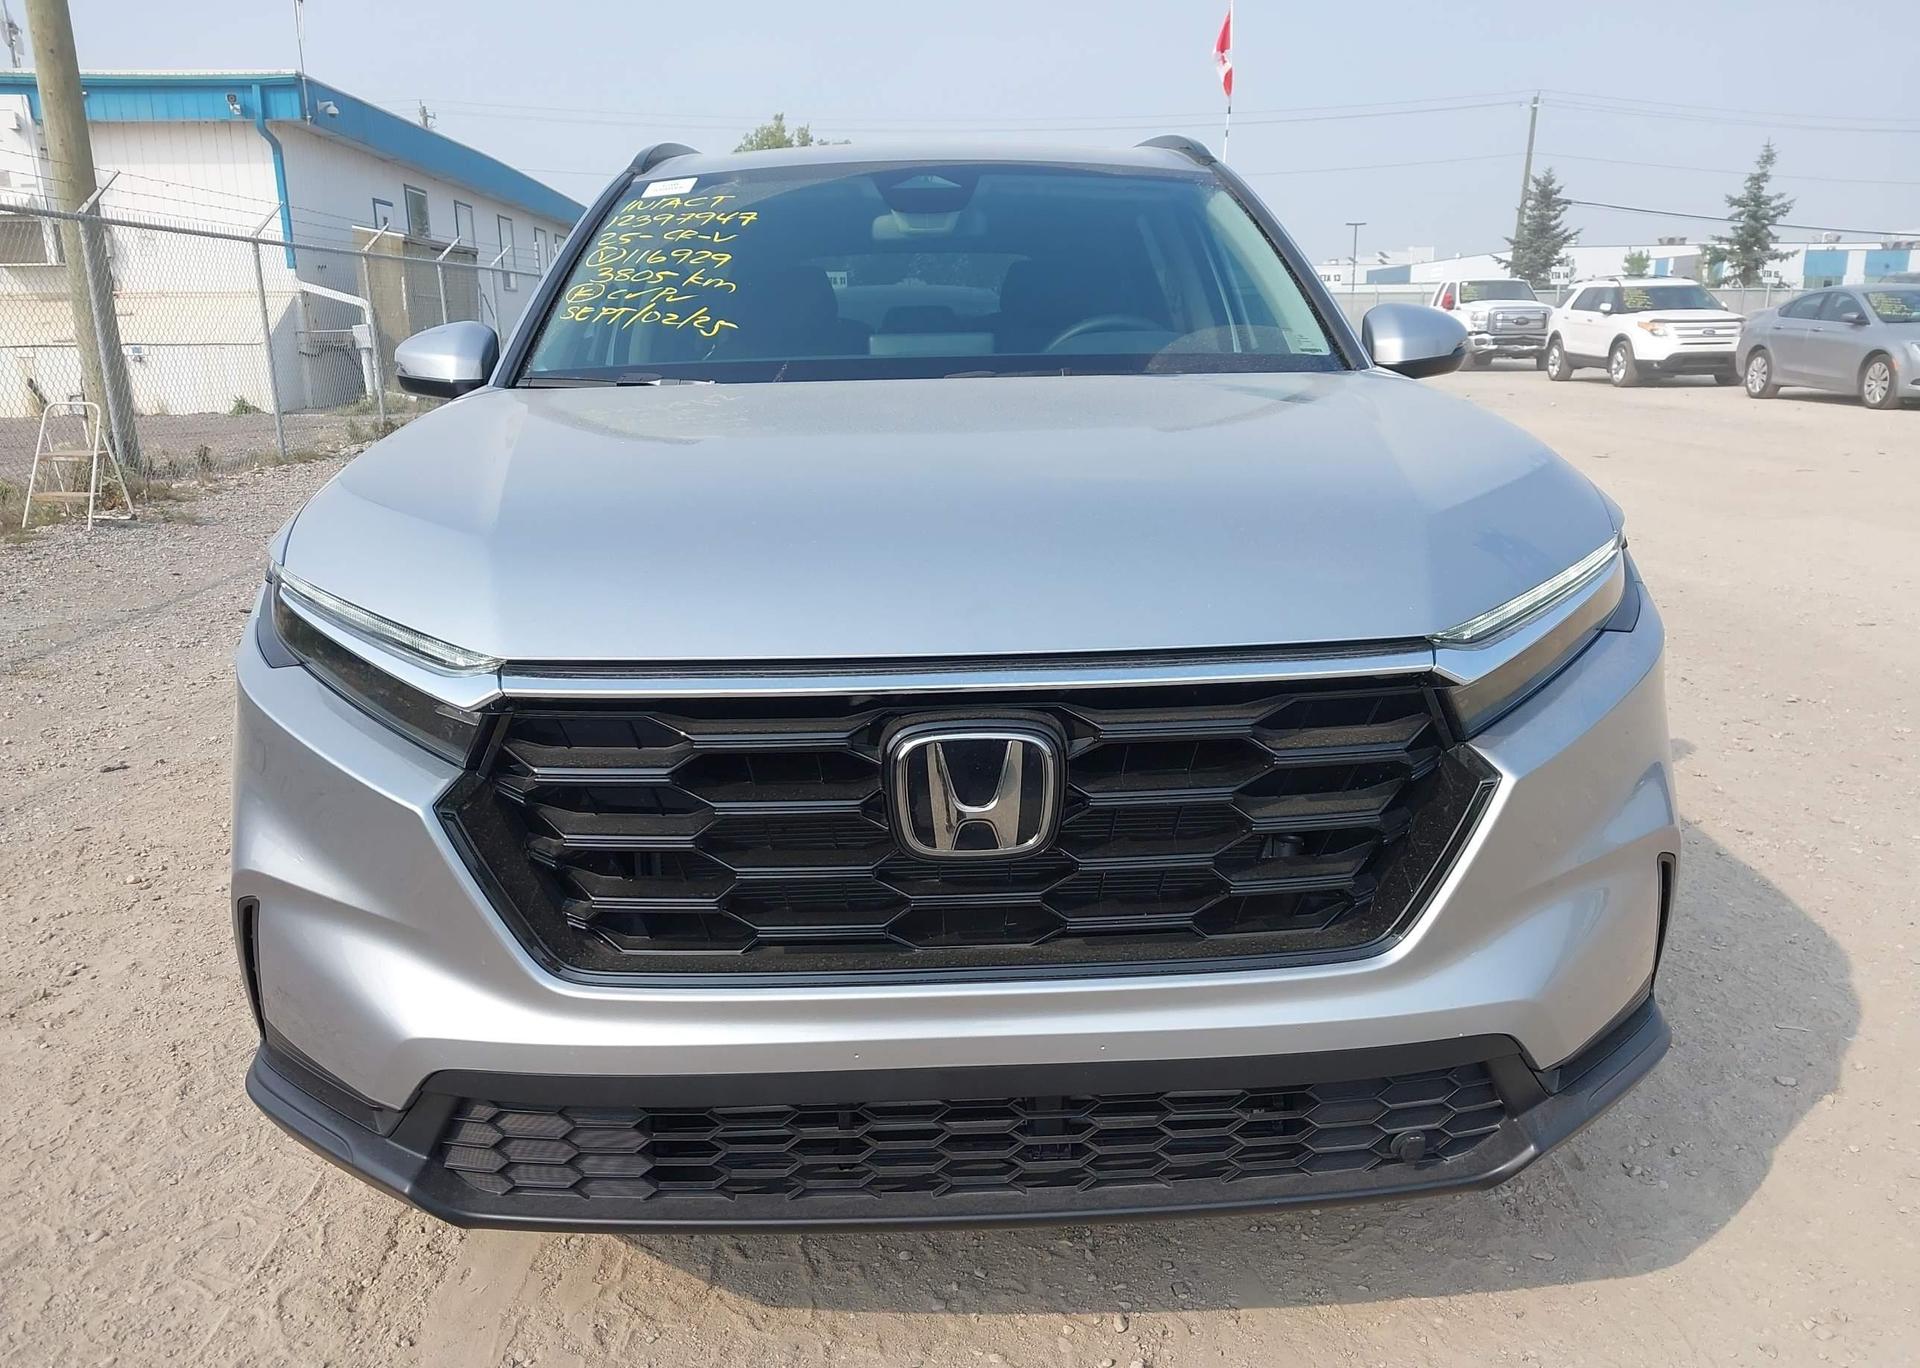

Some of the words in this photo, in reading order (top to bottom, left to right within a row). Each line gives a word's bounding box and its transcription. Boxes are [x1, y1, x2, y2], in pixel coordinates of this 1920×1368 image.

[622, 195, 736, 214] INTACT
[605, 211, 758, 229] 12397947
[589, 267, 680, 284] 3805
